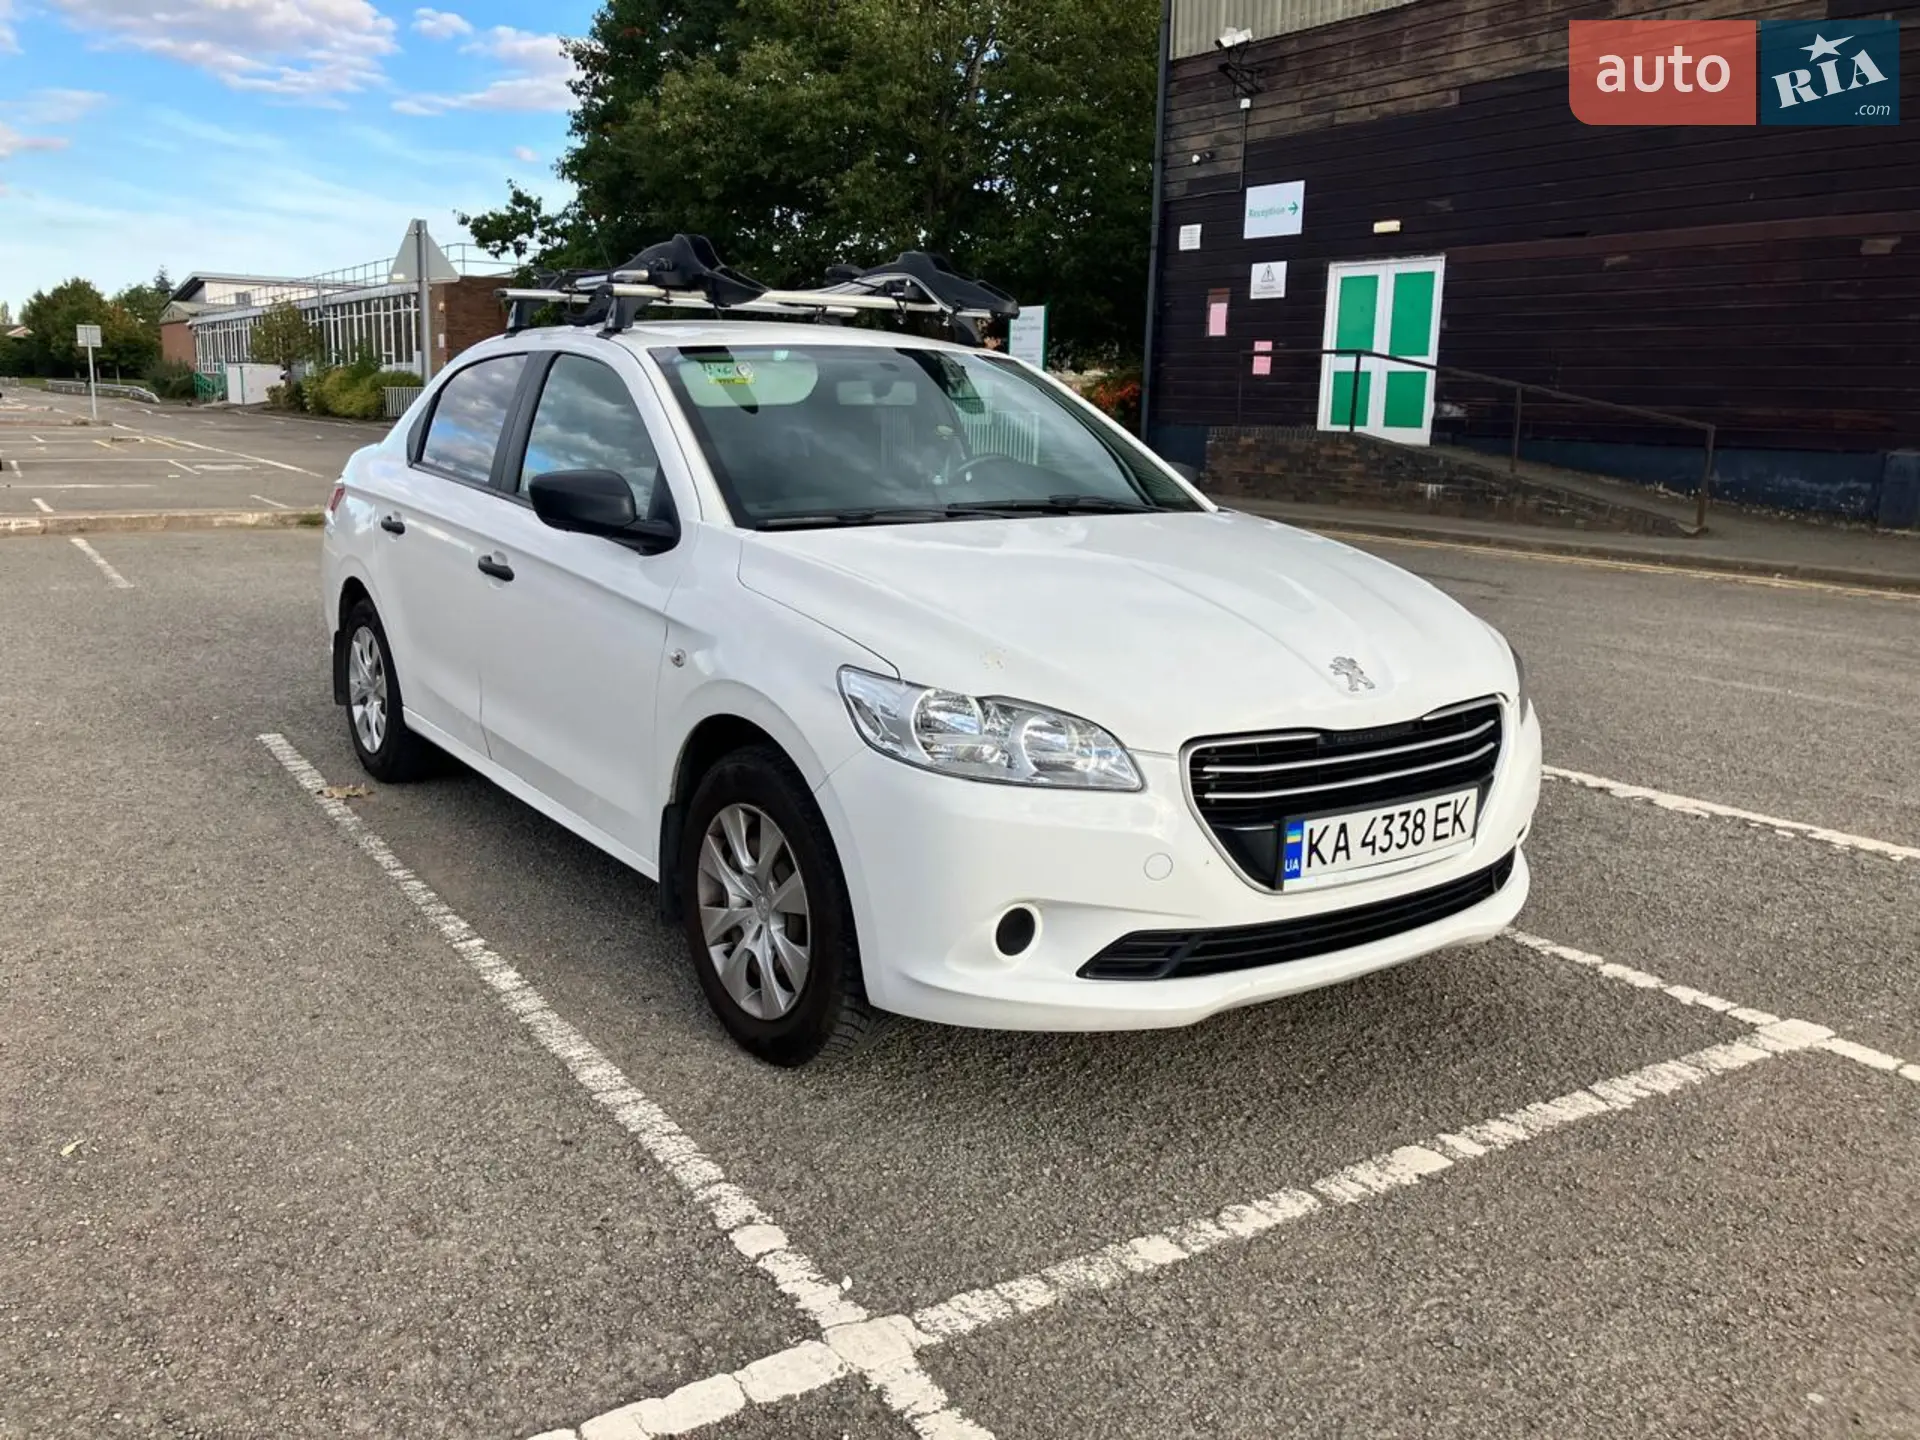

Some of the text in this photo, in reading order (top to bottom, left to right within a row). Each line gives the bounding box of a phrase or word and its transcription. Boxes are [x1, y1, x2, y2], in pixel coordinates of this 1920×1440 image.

[1306, 796, 1470, 868] KA 4338 EK
[1284, 858, 1299, 872] UA
